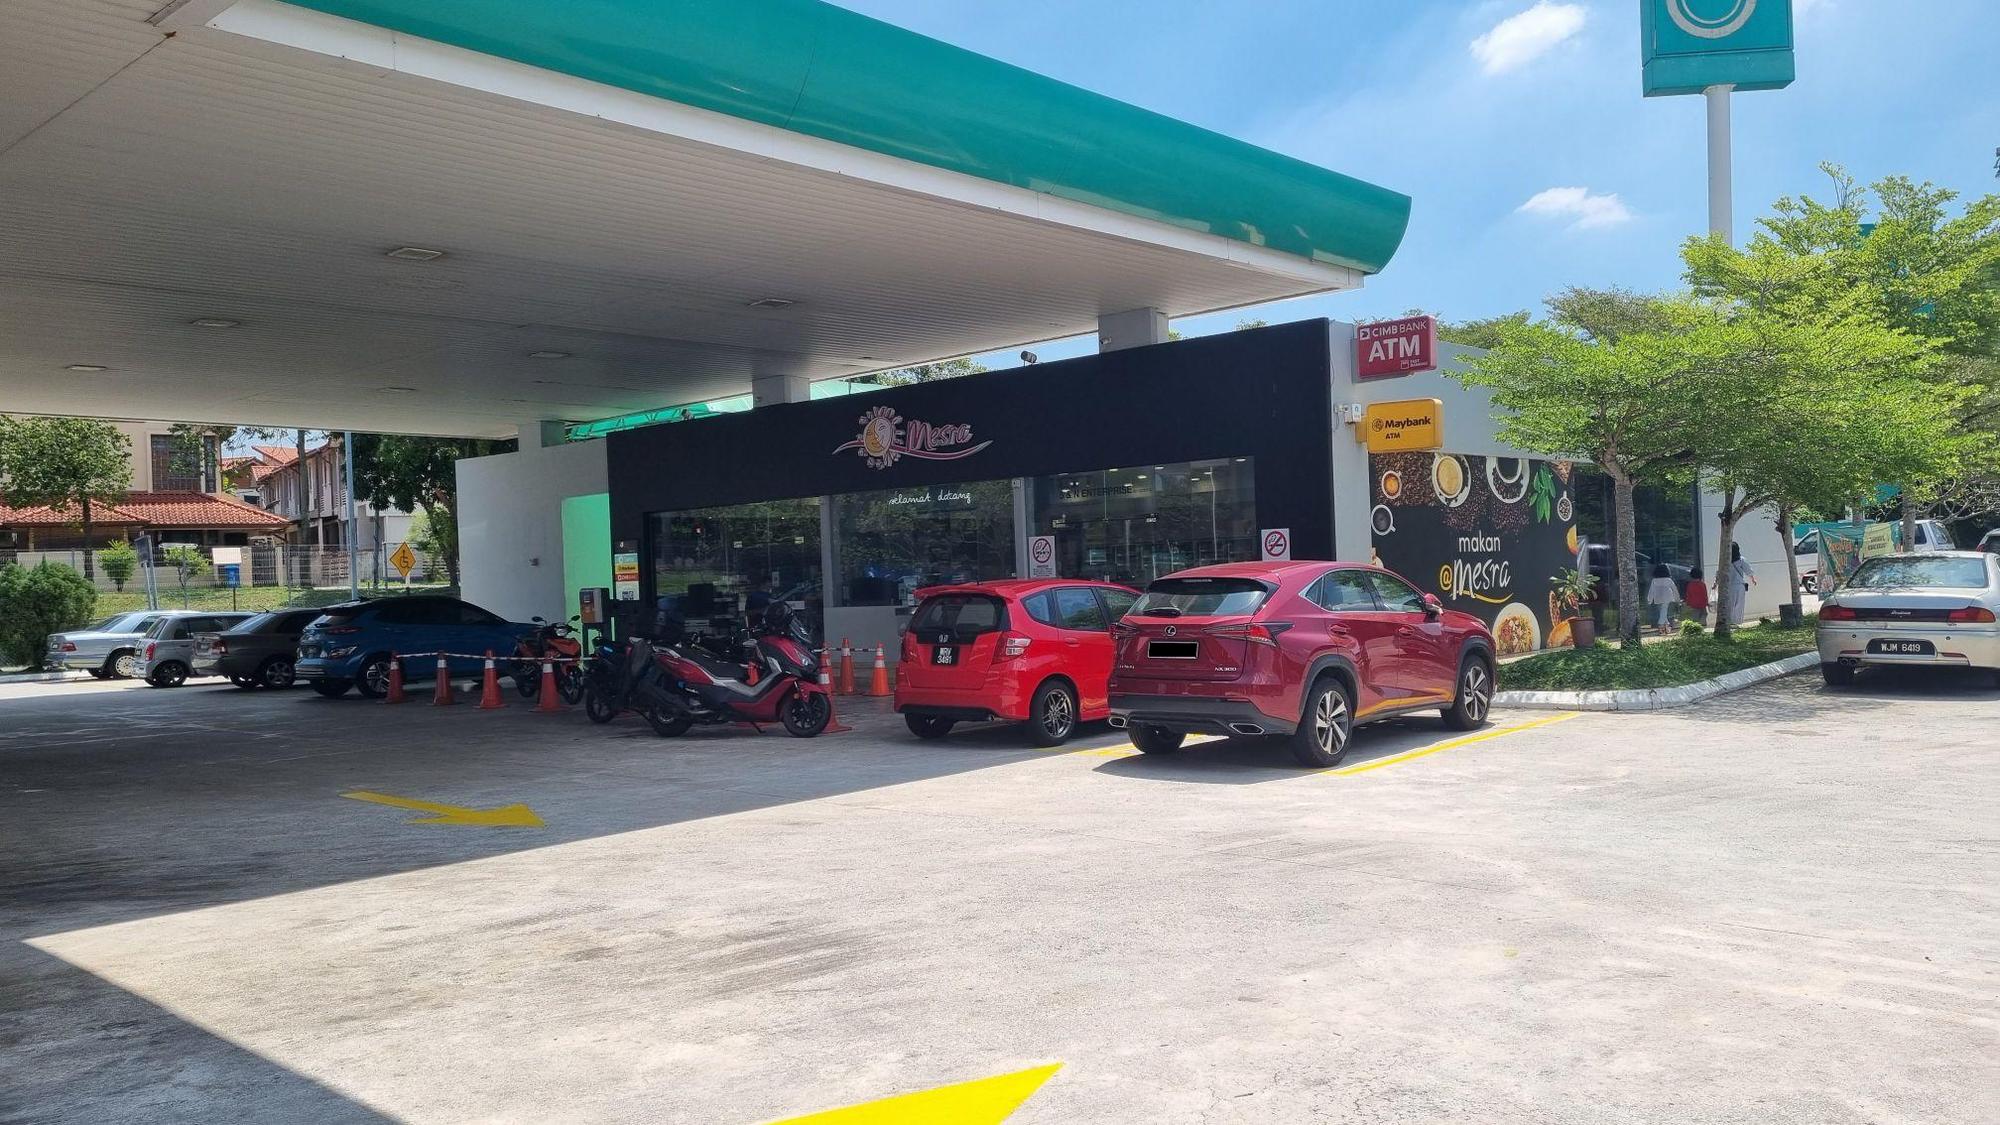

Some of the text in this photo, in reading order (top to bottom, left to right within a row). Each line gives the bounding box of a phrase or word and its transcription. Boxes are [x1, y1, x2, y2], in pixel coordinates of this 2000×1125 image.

[1372, 321, 1427, 337] CIMB BANK
[1368, 334, 1420, 362] ATM
[1385, 416, 1431, 429] Maybank
[1385, 432, 1401, 440] ATM
[937, 490, 972, 505] datang
[1081, 485, 1133, 497] ENTERPRISE
[1458, 530, 1501, 552] makan
[1881, 643, 1921, 652] WJM 6419
